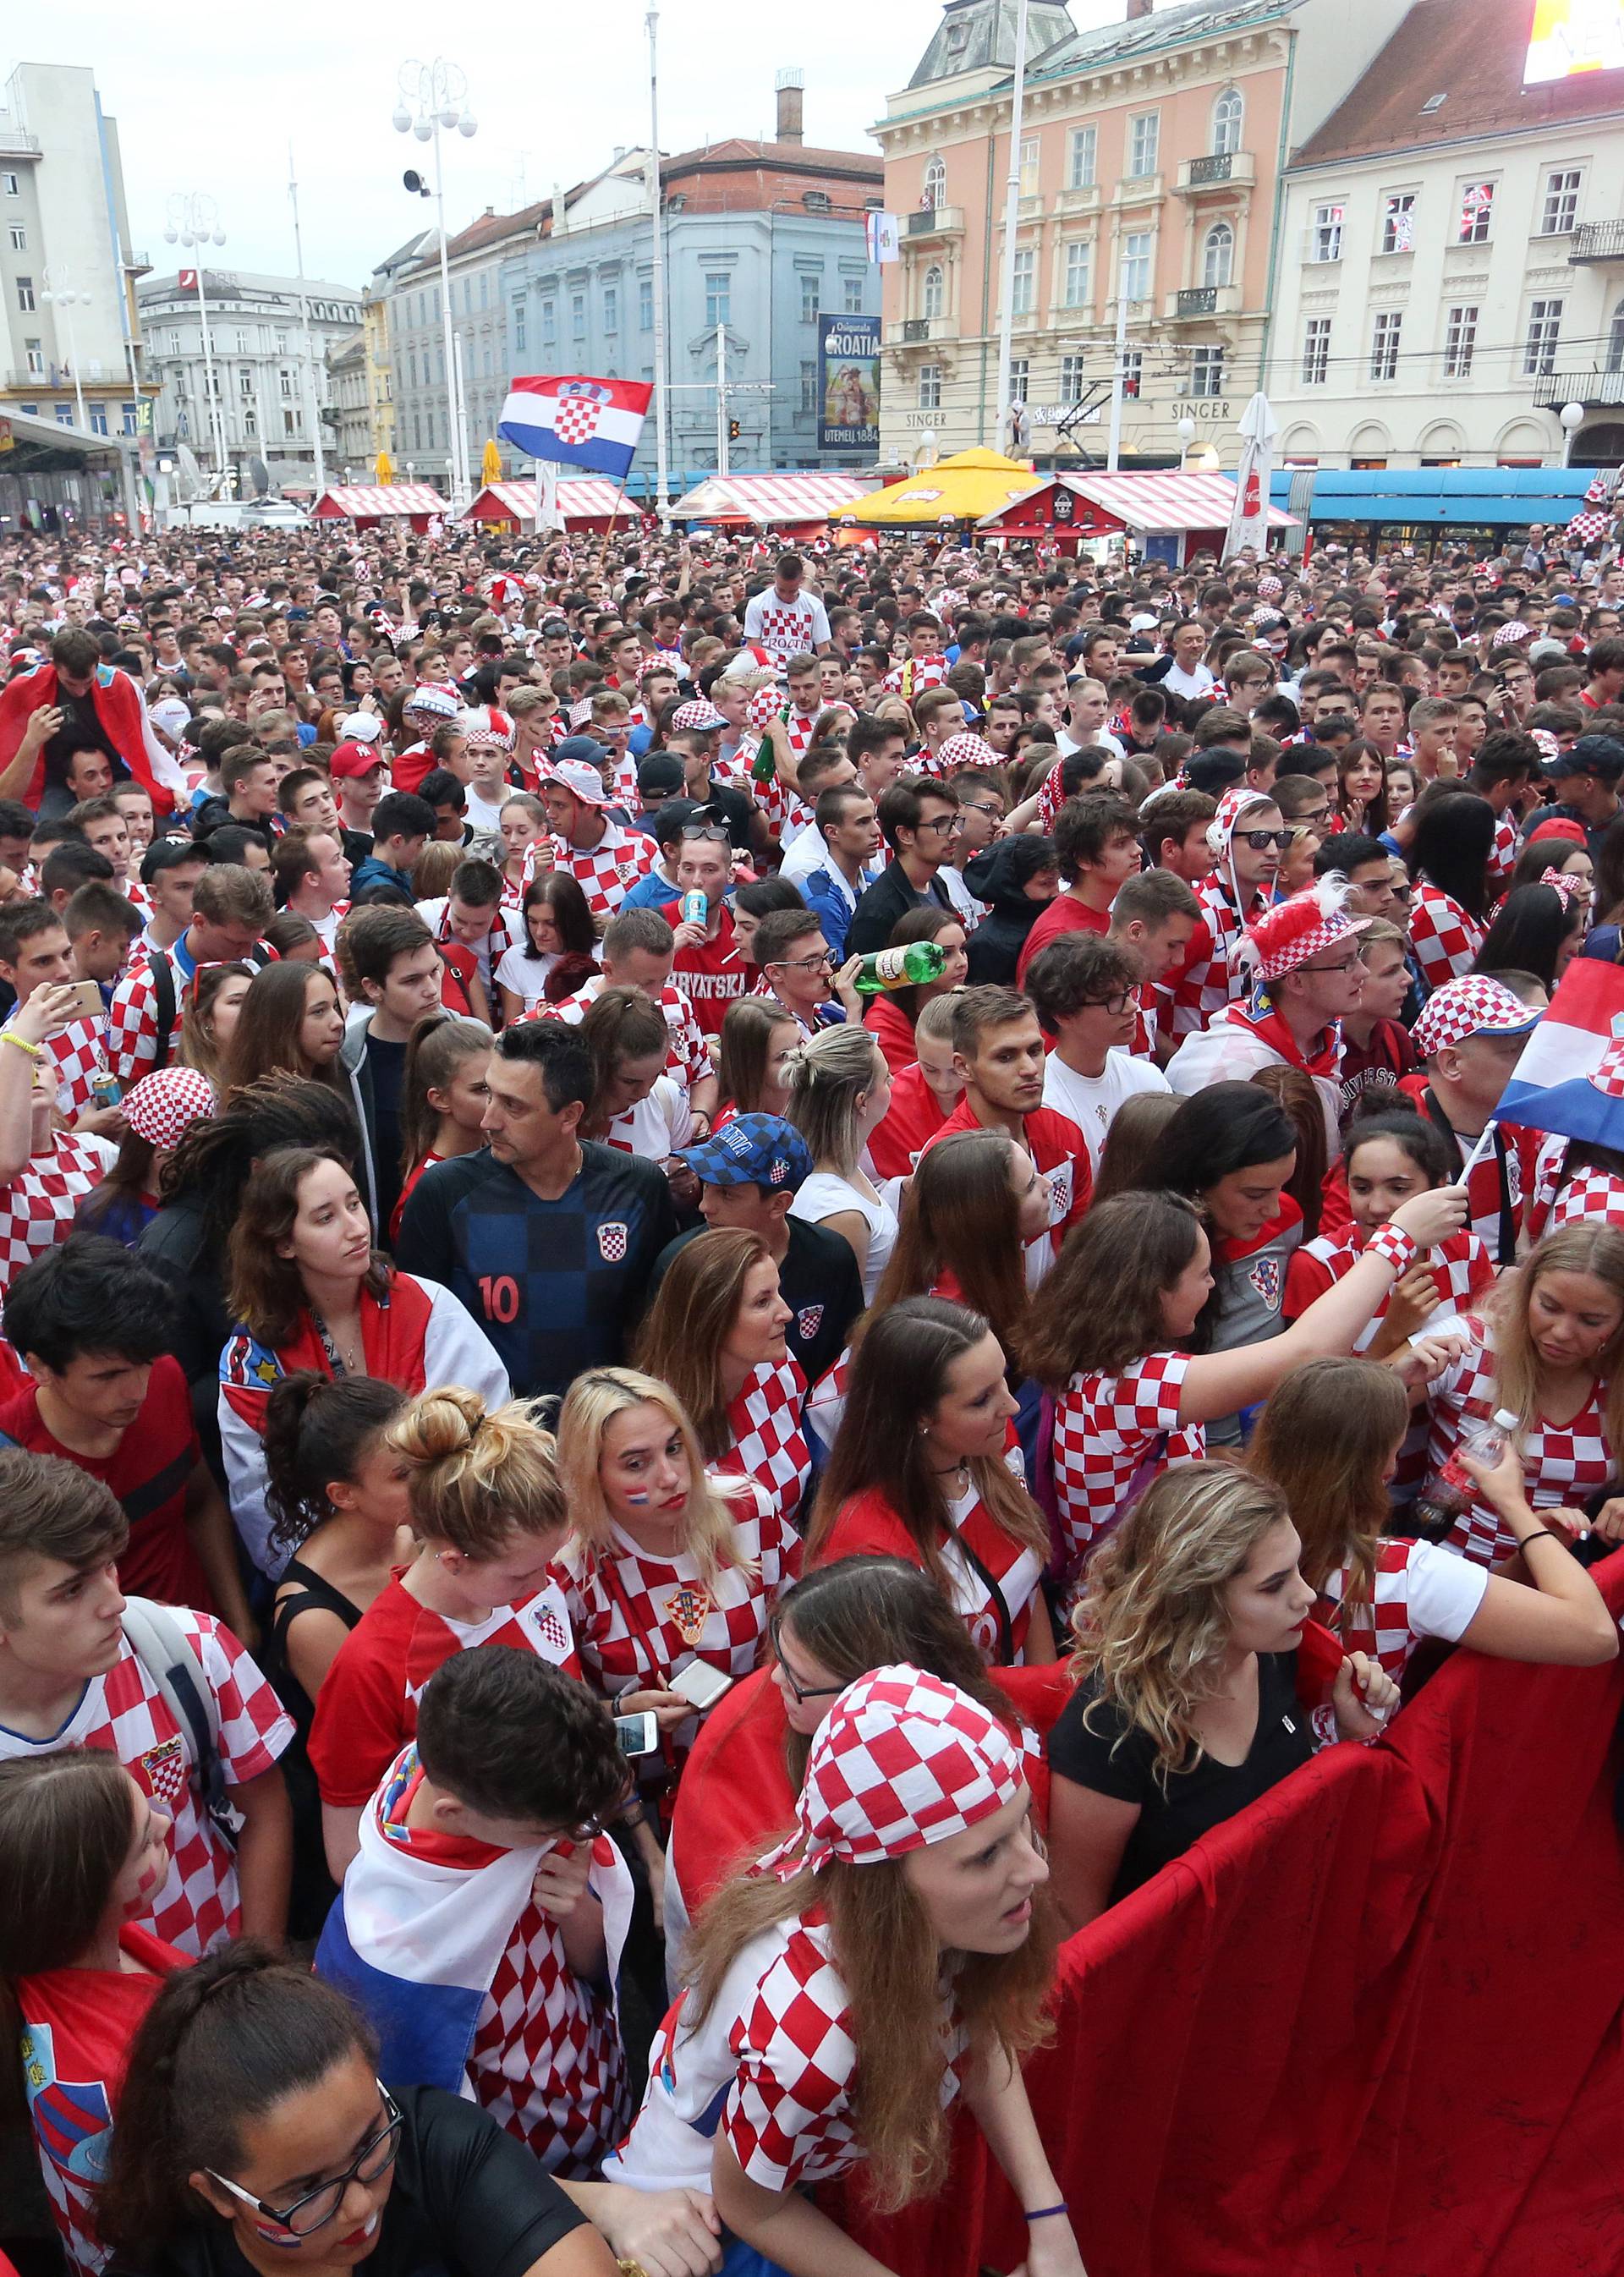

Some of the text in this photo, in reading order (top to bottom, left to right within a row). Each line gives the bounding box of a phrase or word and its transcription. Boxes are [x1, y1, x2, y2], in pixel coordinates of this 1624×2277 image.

[906, 413, 947, 427] SINGER
[1171, 402, 1230, 420] SINGER
[478, 1275, 519, 1324] 10
